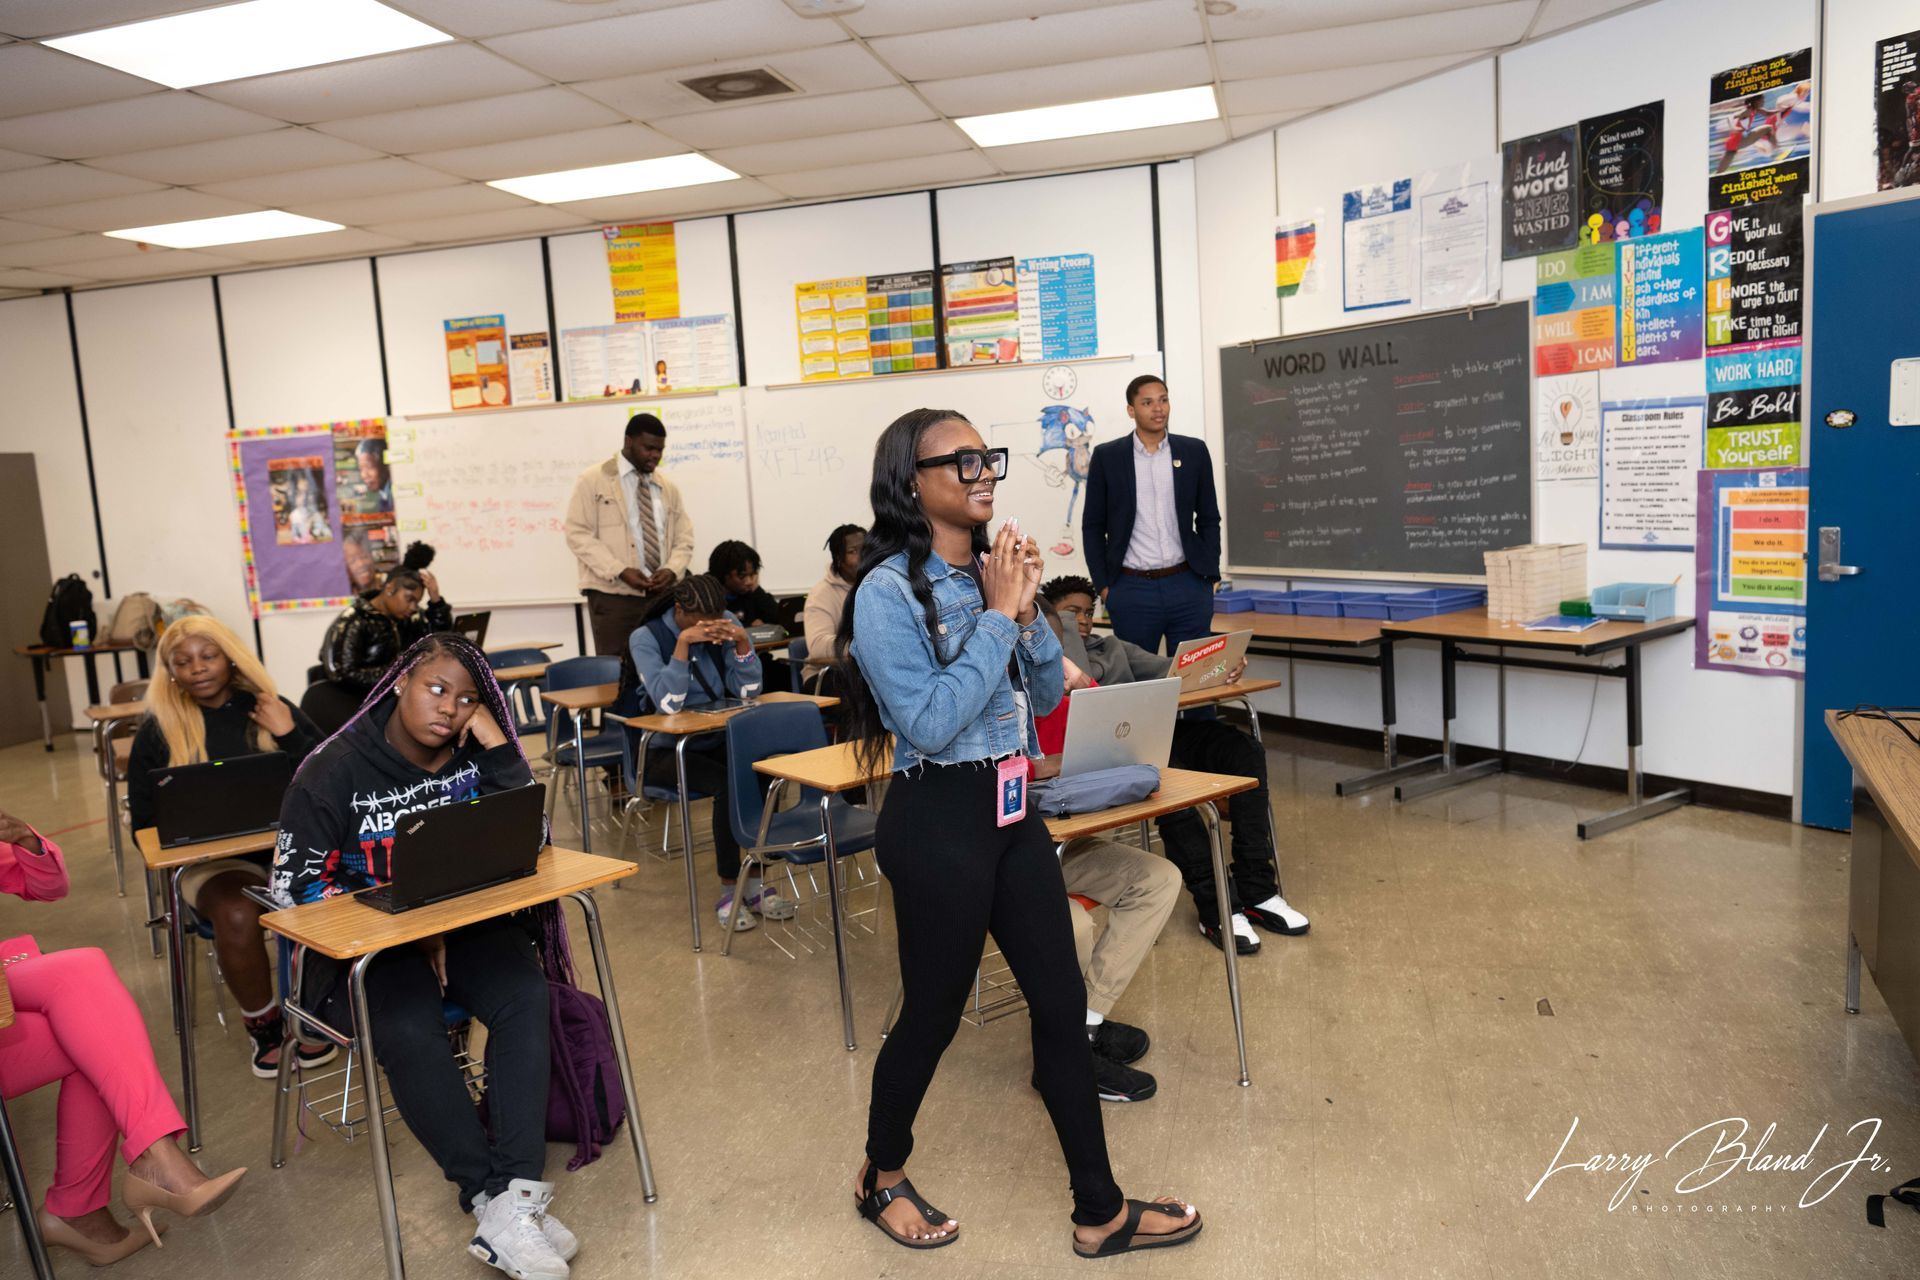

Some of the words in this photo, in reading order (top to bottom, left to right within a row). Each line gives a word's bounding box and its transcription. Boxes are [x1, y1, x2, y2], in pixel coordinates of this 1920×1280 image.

[1724, 72, 1768, 90] finished
[1771, 65, 1793, 78] when
[1731, 70, 1748, 80] You
[1751, 64, 1767, 74] are
[1769, 58, 1787, 70] not
[1740, 84, 1758, 95] you
[1760, 78, 1783, 90] lose.
[1600, 133, 1620, 145] Kind
[1621, 127, 1644, 140] words
[1599, 146, 1612, 155] are
[1612, 143, 1625, 152] the
[1514, 162, 1524, 182] A
[1525, 151, 1569, 180] kind
[1599, 154, 1622, 165] music
[1599, 167, 1608, 175] of
[1609, 165, 1621, 174] the
[1739, 170, 1757, 181] You
[1759, 166, 1776, 176] are
[1513, 171, 1569, 200] word
[1599, 175, 1624, 186] world.
[1720, 176, 1773, 194] finished
[1774, 172, 1797, 184] when
[1730, 192, 1748, 204] you
[1751, 186, 1783, 201] quit.
[1515, 205, 1523, 217] is
[1525, 192, 1569, 218] NEVER
[1513, 214, 1570, 236] WASTED
[1744, 228, 1767, 242] your
[1767, 223, 1782, 235] ALL
[1028, 260, 1059, 272] Writing
[1060, 257, 1090, 268] Process
[1545, 260, 1566, 277] DO
[1746, 256, 1790, 272] necessary
[1582, 286, 1587, 302] I
[1590, 283, 1612, 300] AM
[1653, 278, 1682, 291] other
[1769, 281, 1785, 292] the
[1683, 288, 1696, 300] of
[1741, 297, 1762, 309] urge
[1765, 294, 1775, 304] to
[1777, 288, 1799, 302] QUIT
[1544, 321, 1574, 337] WILL
[1750, 316, 1772, 328] time
[1775, 314, 1786, 324] to
[1671, 330, 1682, 338] or
[1747, 328, 1760, 340] DO
[1772, 322, 1798, 336] RIGHT
[1264, 352, 1326, 379] WORD
[1338, 342, 1399, 370] WALL
[1578, 352, 1582, 364] I
[1585, 346, 1613, 362] CAN
[1452, 363, 1463, 378] to
[1465, 360, 1489, 374] take
[1492, 354, 1522, 374] apart
[1715, 363, 1752, 382] WORK
[1757, 358, 1794, 378] HARD
[1663, 412, 1684, 420] Rules
[1713, 398, 1744, 422] Be
[1747, 392, 1796, 420] Bold
[1727, 429, 1783, 447] TRUST
[1539, 448, 1598, 462] LIGHT
[1717, 445, 1793, 464] Yourself
[1181, 640, 1225, 664] Supreme
[1115, 721, 1131, 738] hp
